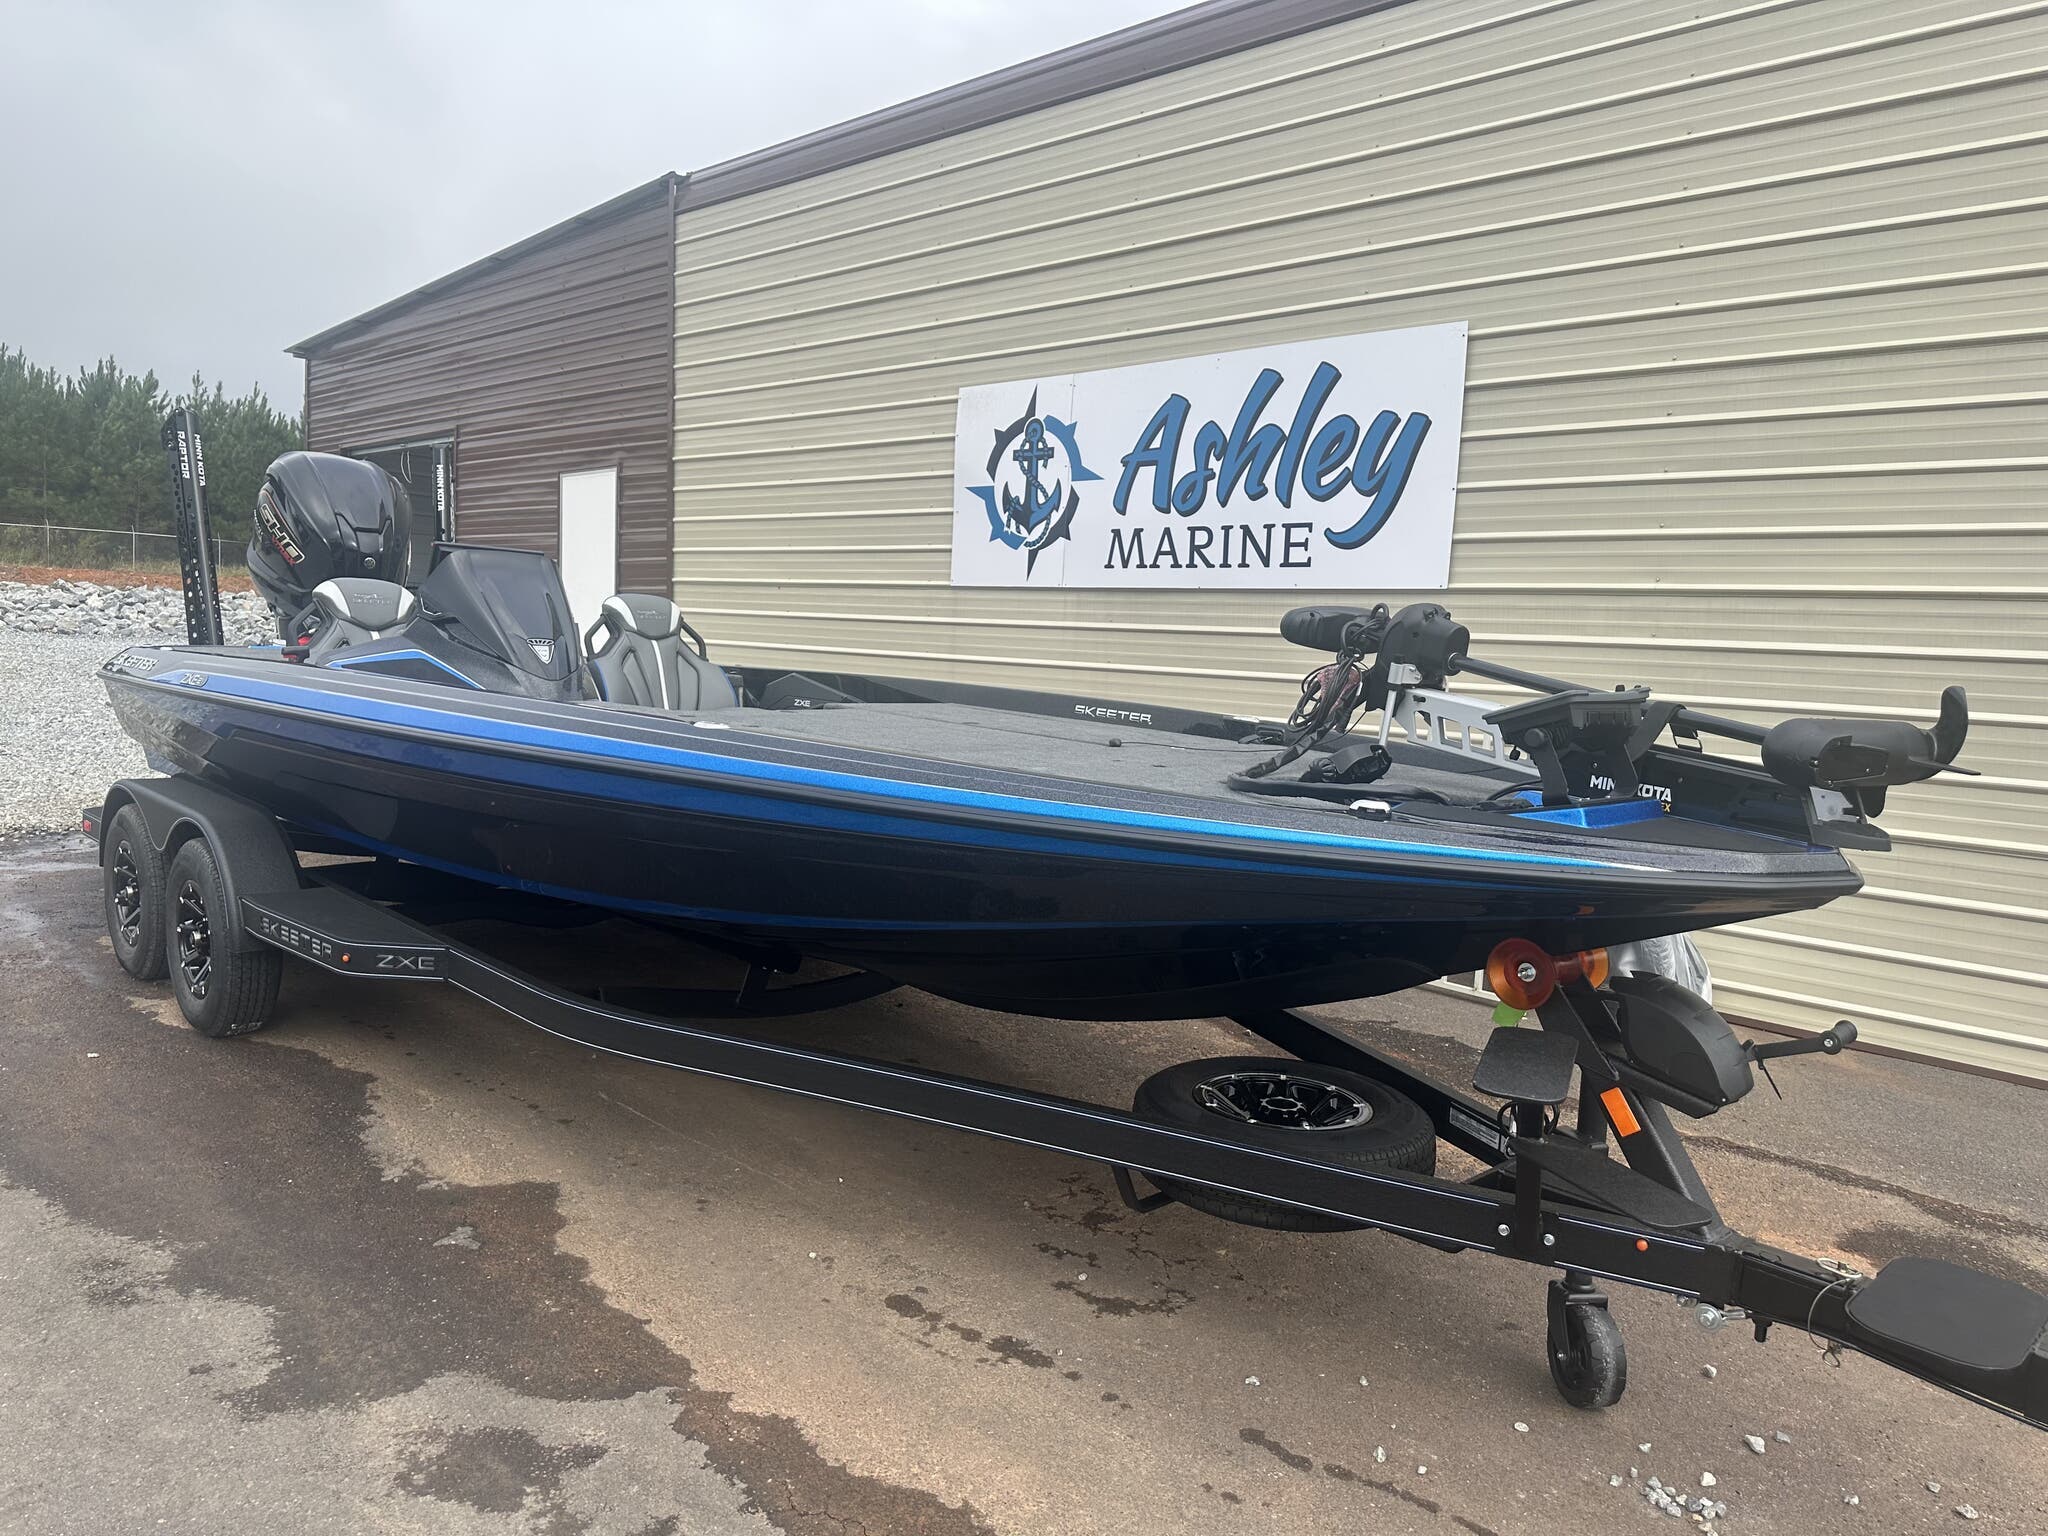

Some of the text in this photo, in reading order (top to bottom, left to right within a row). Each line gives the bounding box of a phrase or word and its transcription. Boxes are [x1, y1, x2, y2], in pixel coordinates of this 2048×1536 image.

[177, 431, 190, 479] RAPTOR
[194, 433, 206, 487] MINN KOTA
[1112, 361, 1432, 550] Ashley
[436, 464, 445, 512] MINN KOTA
[260, 503, 305, 564] SHO
[1103, 522, 1313, 569] MARINE
[793, 698, 811, 707] ZXE
[1074, 704, 1152, 724] SKEETER
[1589, 774, 1616, 791] MIN
[259, 917, 332, 958] SKEETER
[375, 954, 435, 971] ZXE
